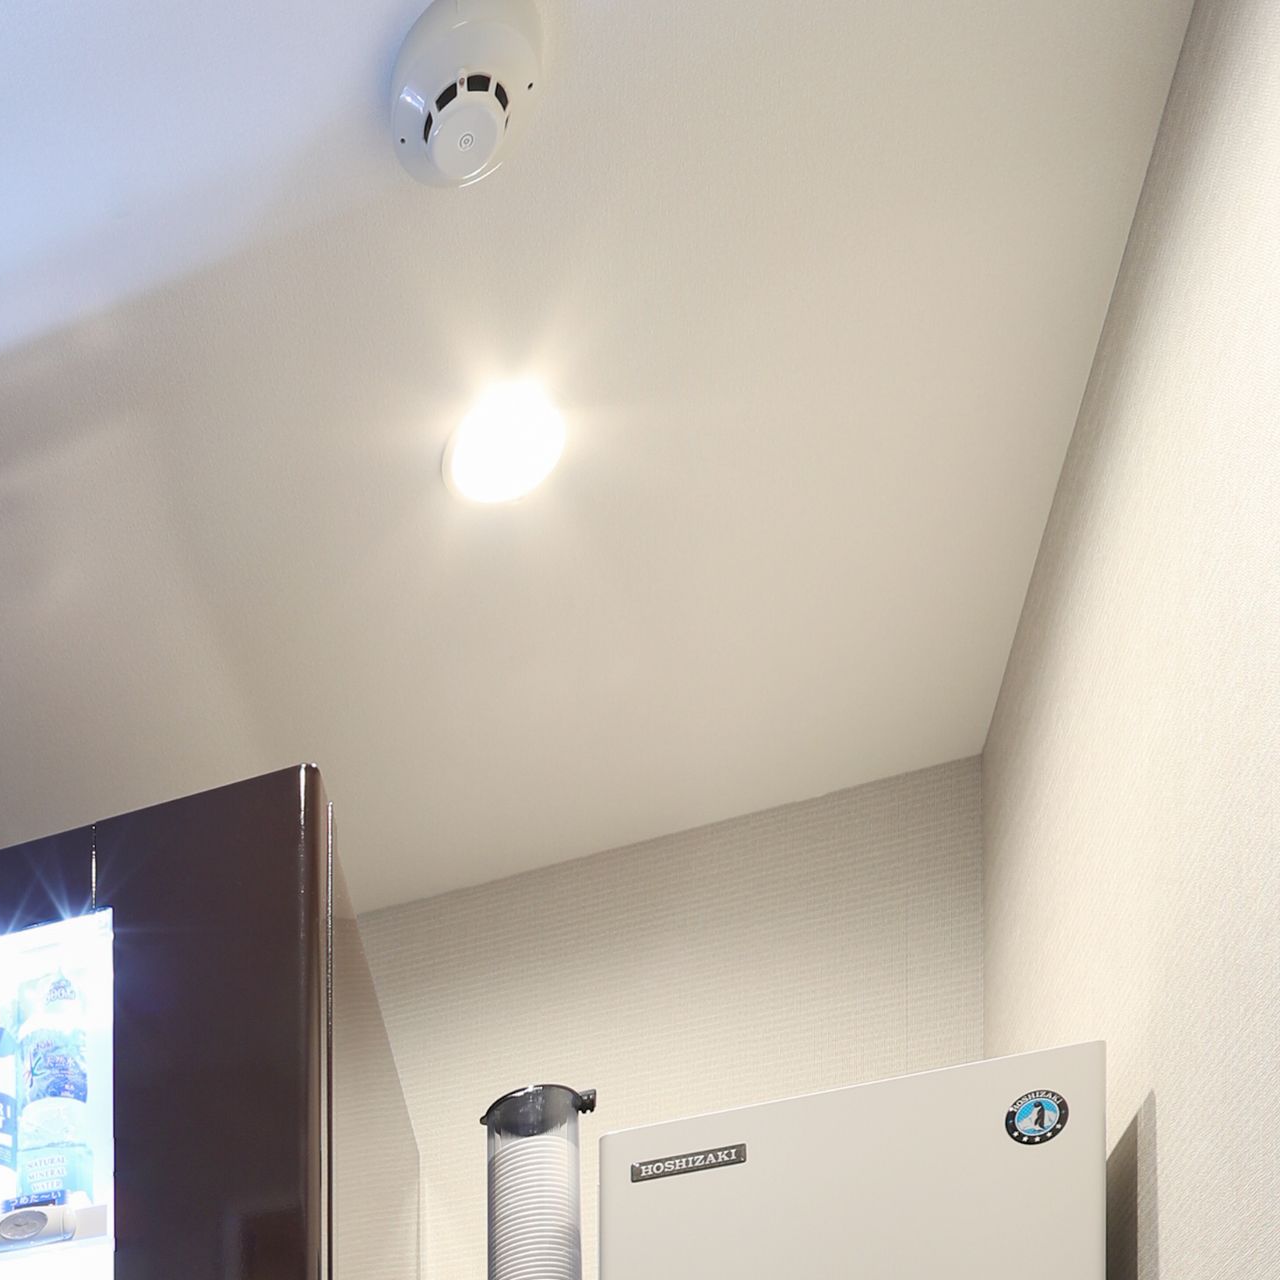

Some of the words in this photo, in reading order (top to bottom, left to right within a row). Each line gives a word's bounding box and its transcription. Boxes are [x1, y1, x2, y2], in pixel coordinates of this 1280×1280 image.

[1013, 1090, 1063, 1112] HOSHIZAKI
[28, 1156, 65, 1169] NATURAL
[640, 1149, 737, 1177] HOSHIZAKI
[28, 1168, 65, 1181] MINERAL
[32, 1180, 62, 1191] WATER
